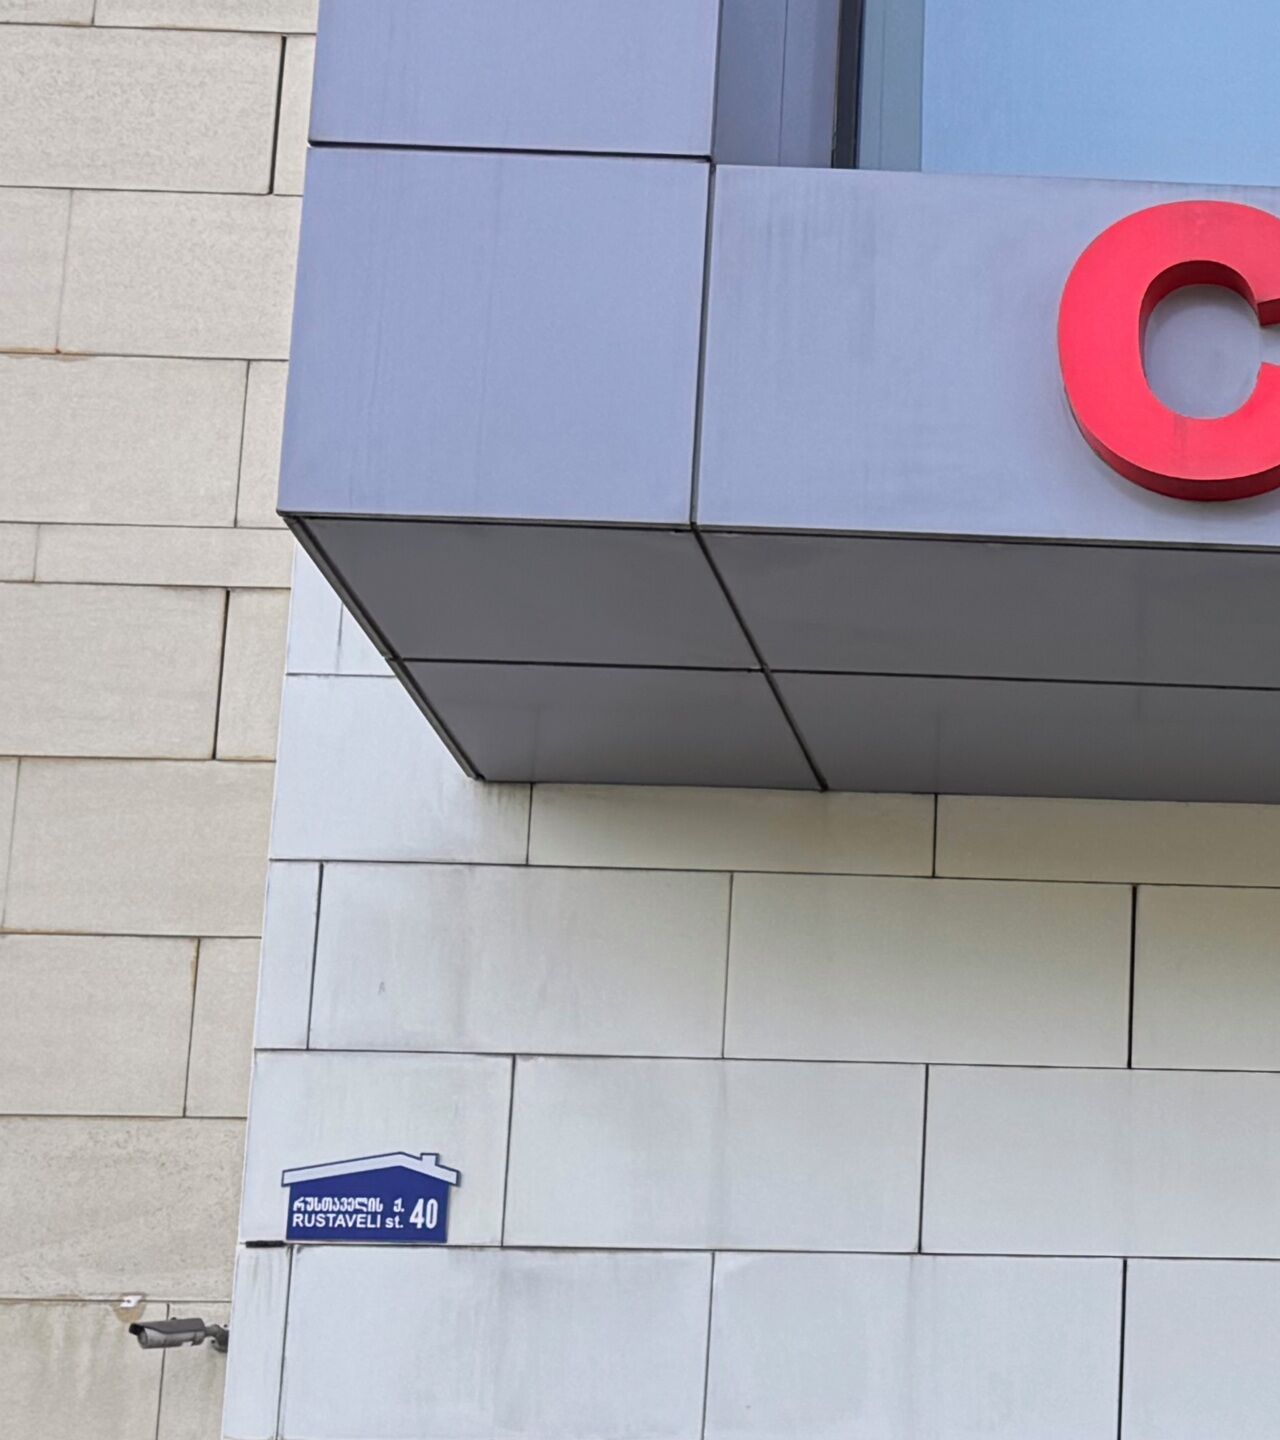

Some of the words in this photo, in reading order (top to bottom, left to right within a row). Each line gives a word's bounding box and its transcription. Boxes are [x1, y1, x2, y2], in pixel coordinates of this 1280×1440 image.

[292, 1196, 384, 1213] რუსთაველის
[292, 1212, 381, 1229] RUSTAVELI
[385, 1216, 404, 1229] st.
[409, 1198, 439, 1230] 40
